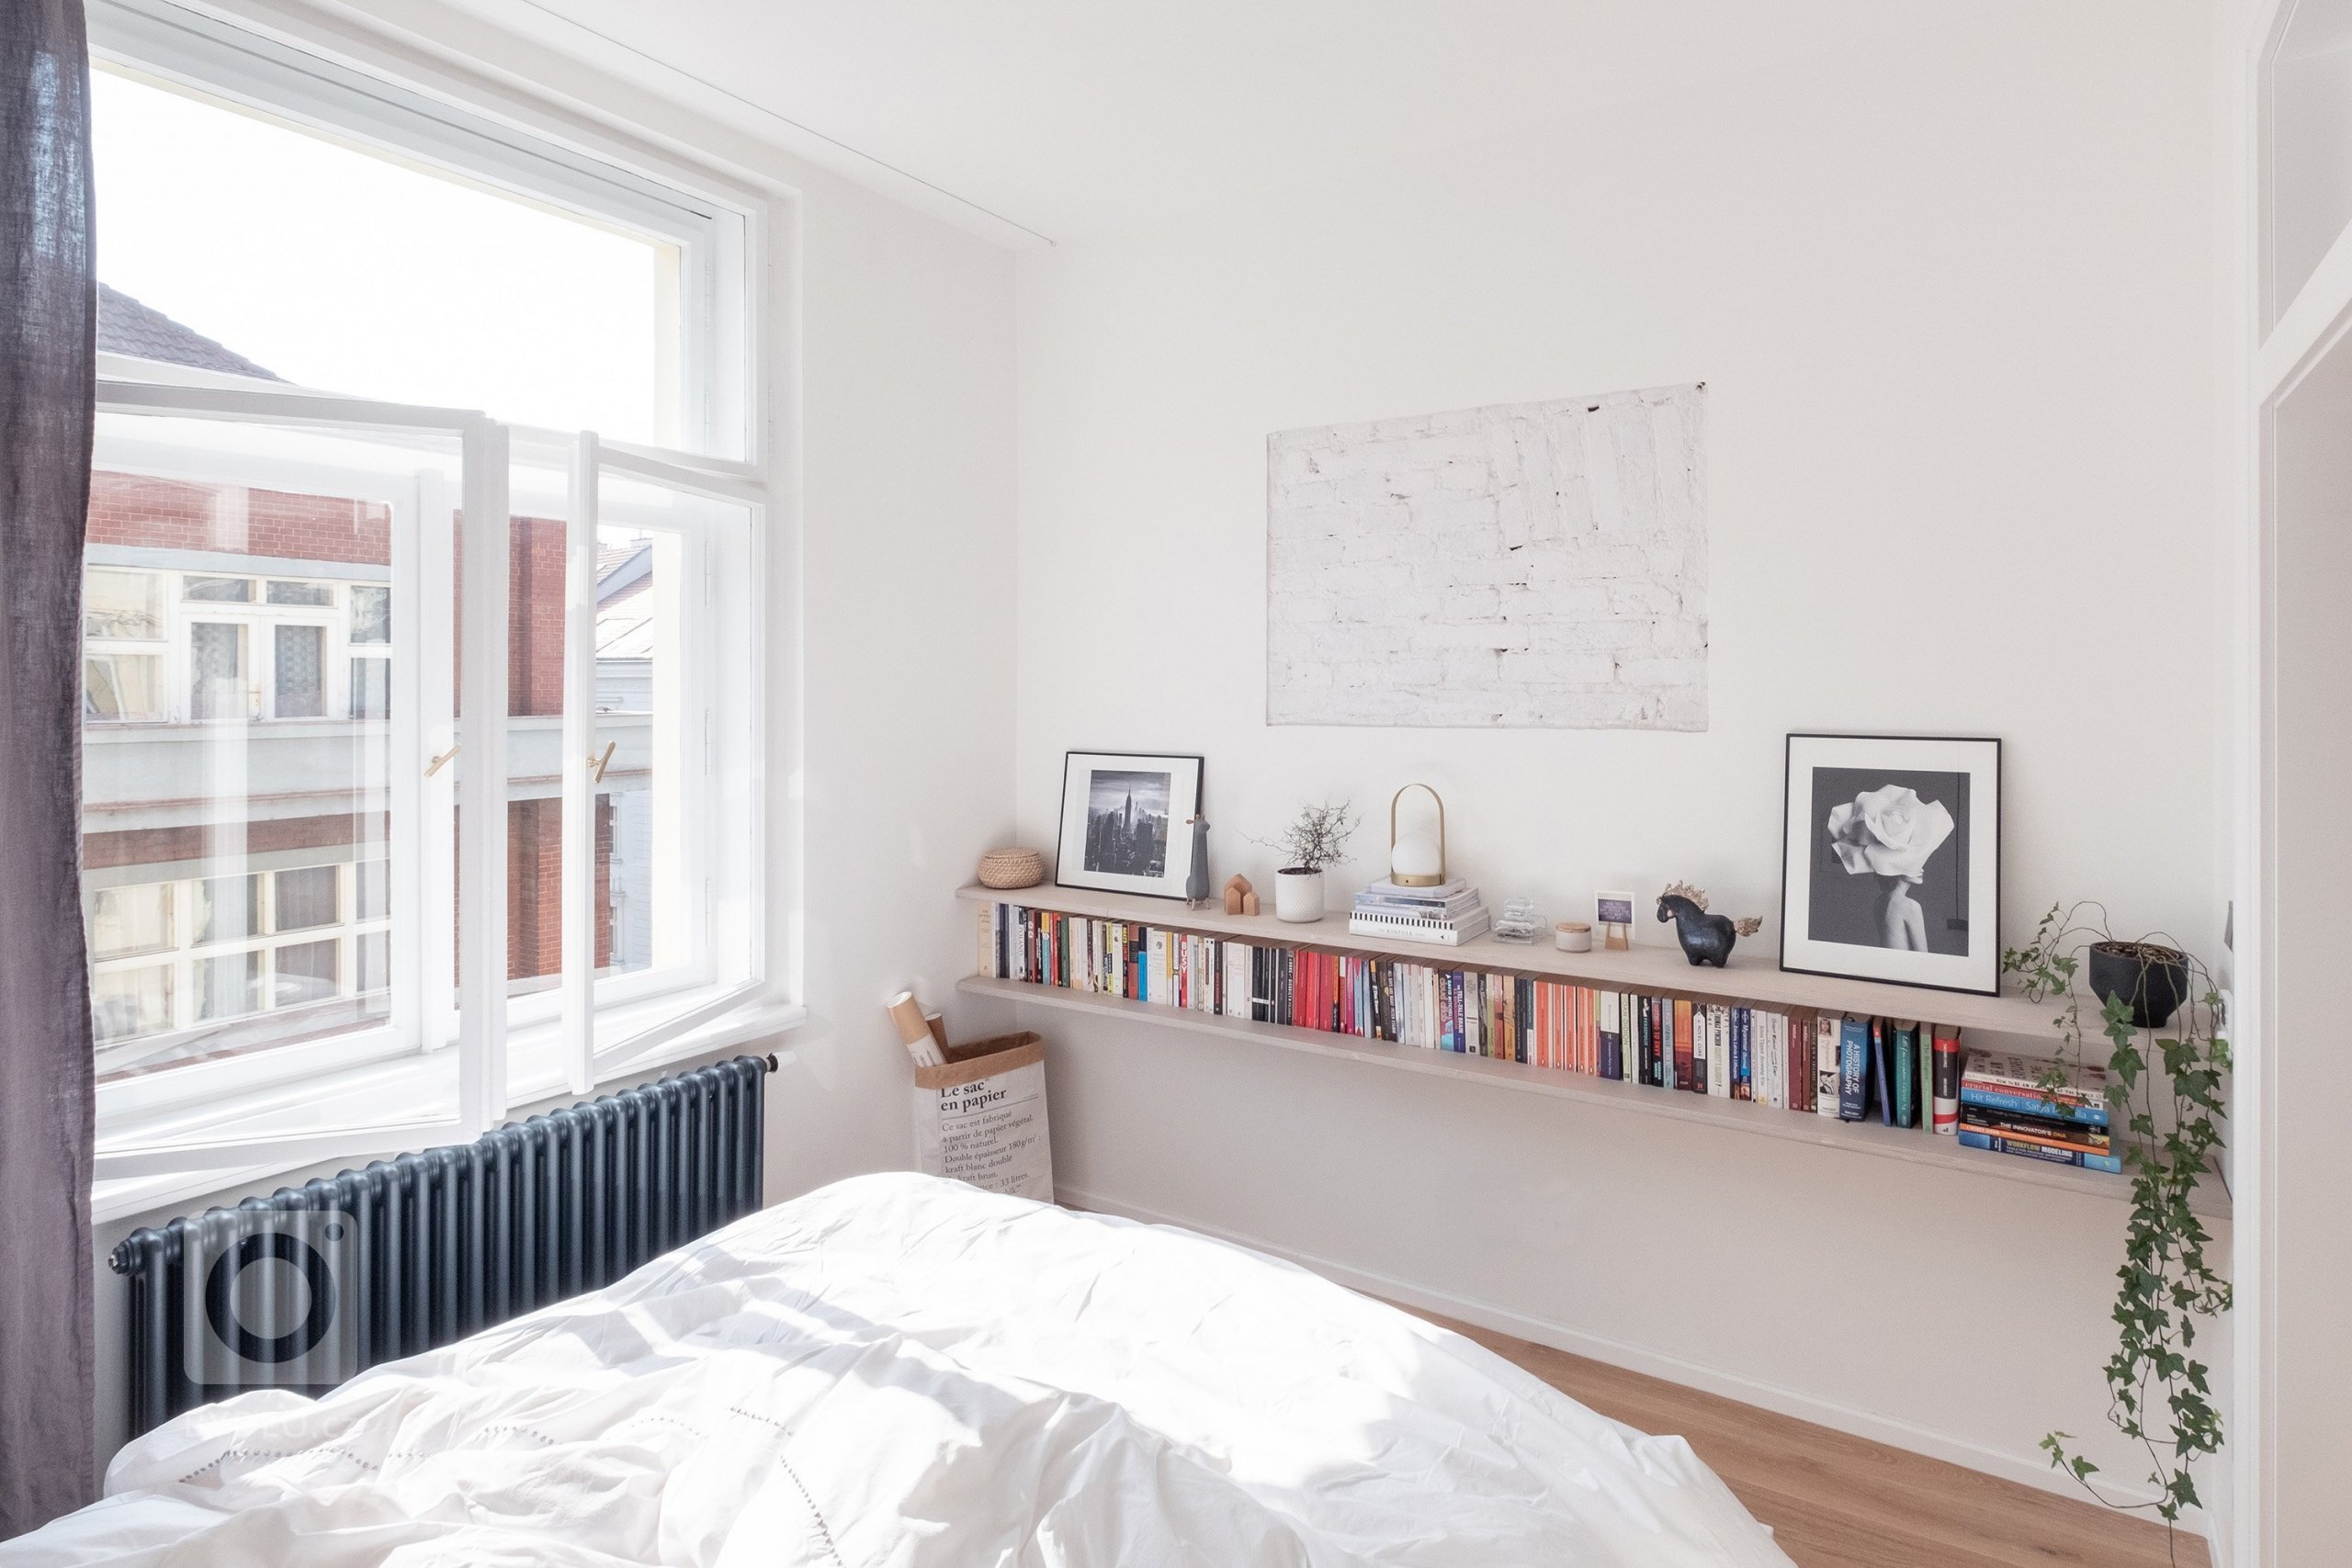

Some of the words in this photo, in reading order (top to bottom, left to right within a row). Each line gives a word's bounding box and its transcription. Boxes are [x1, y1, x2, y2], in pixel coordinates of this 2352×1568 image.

[1844, 1040, 1854, 1096] PHOTOGRAPHY
[1852, 1050, 1860, 1082] HISTORY
[940, 1086, 959, 1099] Le
[963, 1081, 985, 1095] sac
[1852, 1082, 1860, 1093] OF
[1965, 1083, 1993, 1092] crucial
[1995, 1088, 2043, 1100] conversatio
[940, 1101, 958, 1111] en
[961, 1089, 1007, 1113] papier
[1971, 1093, 1983, 1101] Hit
[1985, 1095, 2018, 1108] Refresh
[2025, 1101, 2050, 1113] Satya
[942, 1123, 954, 1132] Ce
[982, 1111, 1012, 1125] fabriqué
[949, 1134, 972, 1145] partir
[972, 1129, 982, 1138] de
[984, 1123, 1007, 1136] papier
[1008, 1114, 1034, 1128] végétal.
[2012, 1124, 2052, 1136] INNOVATOR'S
[944, 1145, 959, 1154] 100
[970, 1135, 999, 1149] naturel.
[2006, 1140, 2041, 1152] WORKFLOW
[2041, 1145, 2073, 1157] MODELING
[944, 1153, 973, 1164] Double
[974, 1145, 1008, 1161] épaisseur
[945, 1164, 964, 1174] kraft
[966, 1162, 986, 1171] blanc
[988, 1155, 1013, 1168] doublé
[1000, 1179, 1010, 1188] 33
